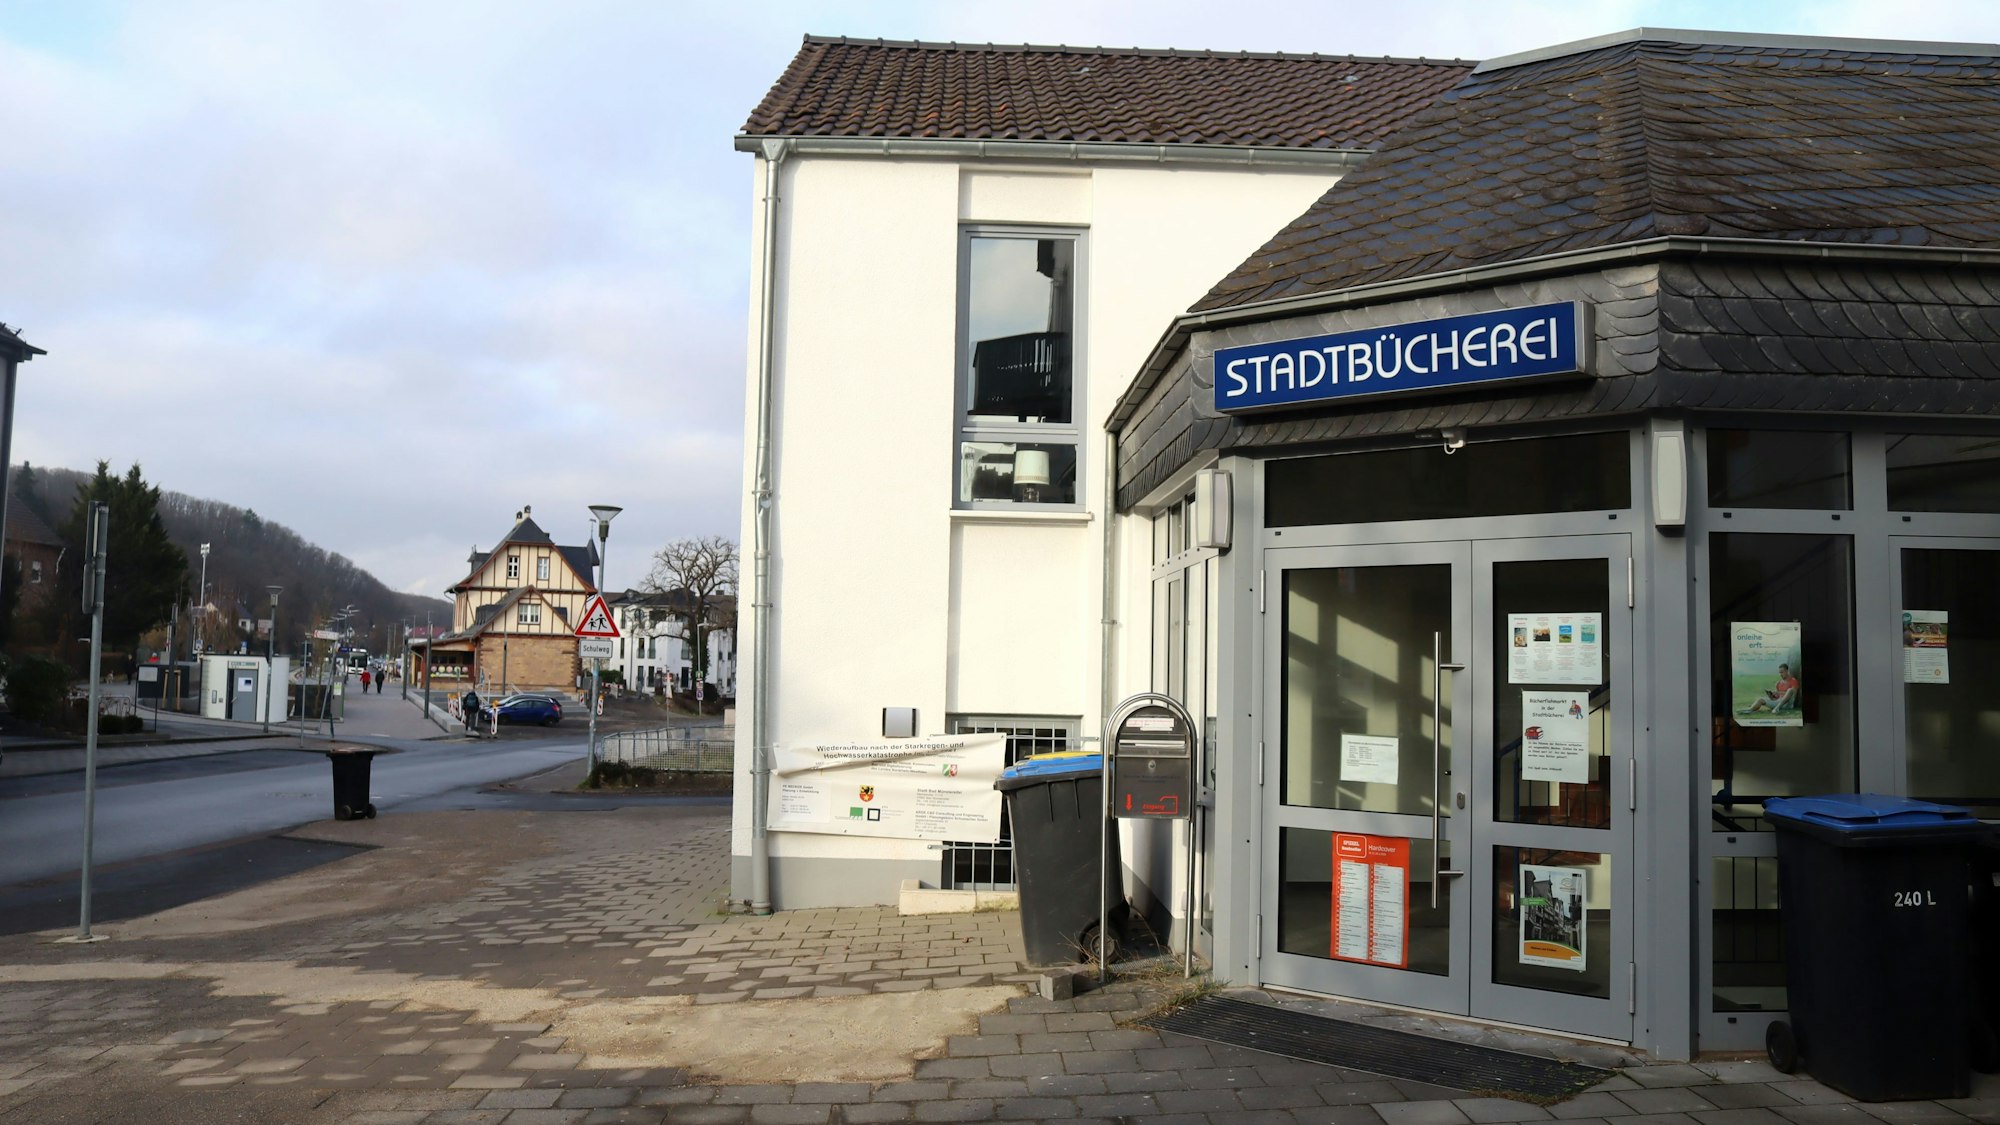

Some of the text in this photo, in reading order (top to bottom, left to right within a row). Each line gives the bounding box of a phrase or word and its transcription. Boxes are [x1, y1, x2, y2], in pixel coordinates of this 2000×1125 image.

[1226, 316, 1557, 397] STADTBÜCHEREI
[583, 645, 610, 655] Schulweg
[1368, 845, 1396, 853] Hardcover
[1894, 890, 1937, 907] 240 L
